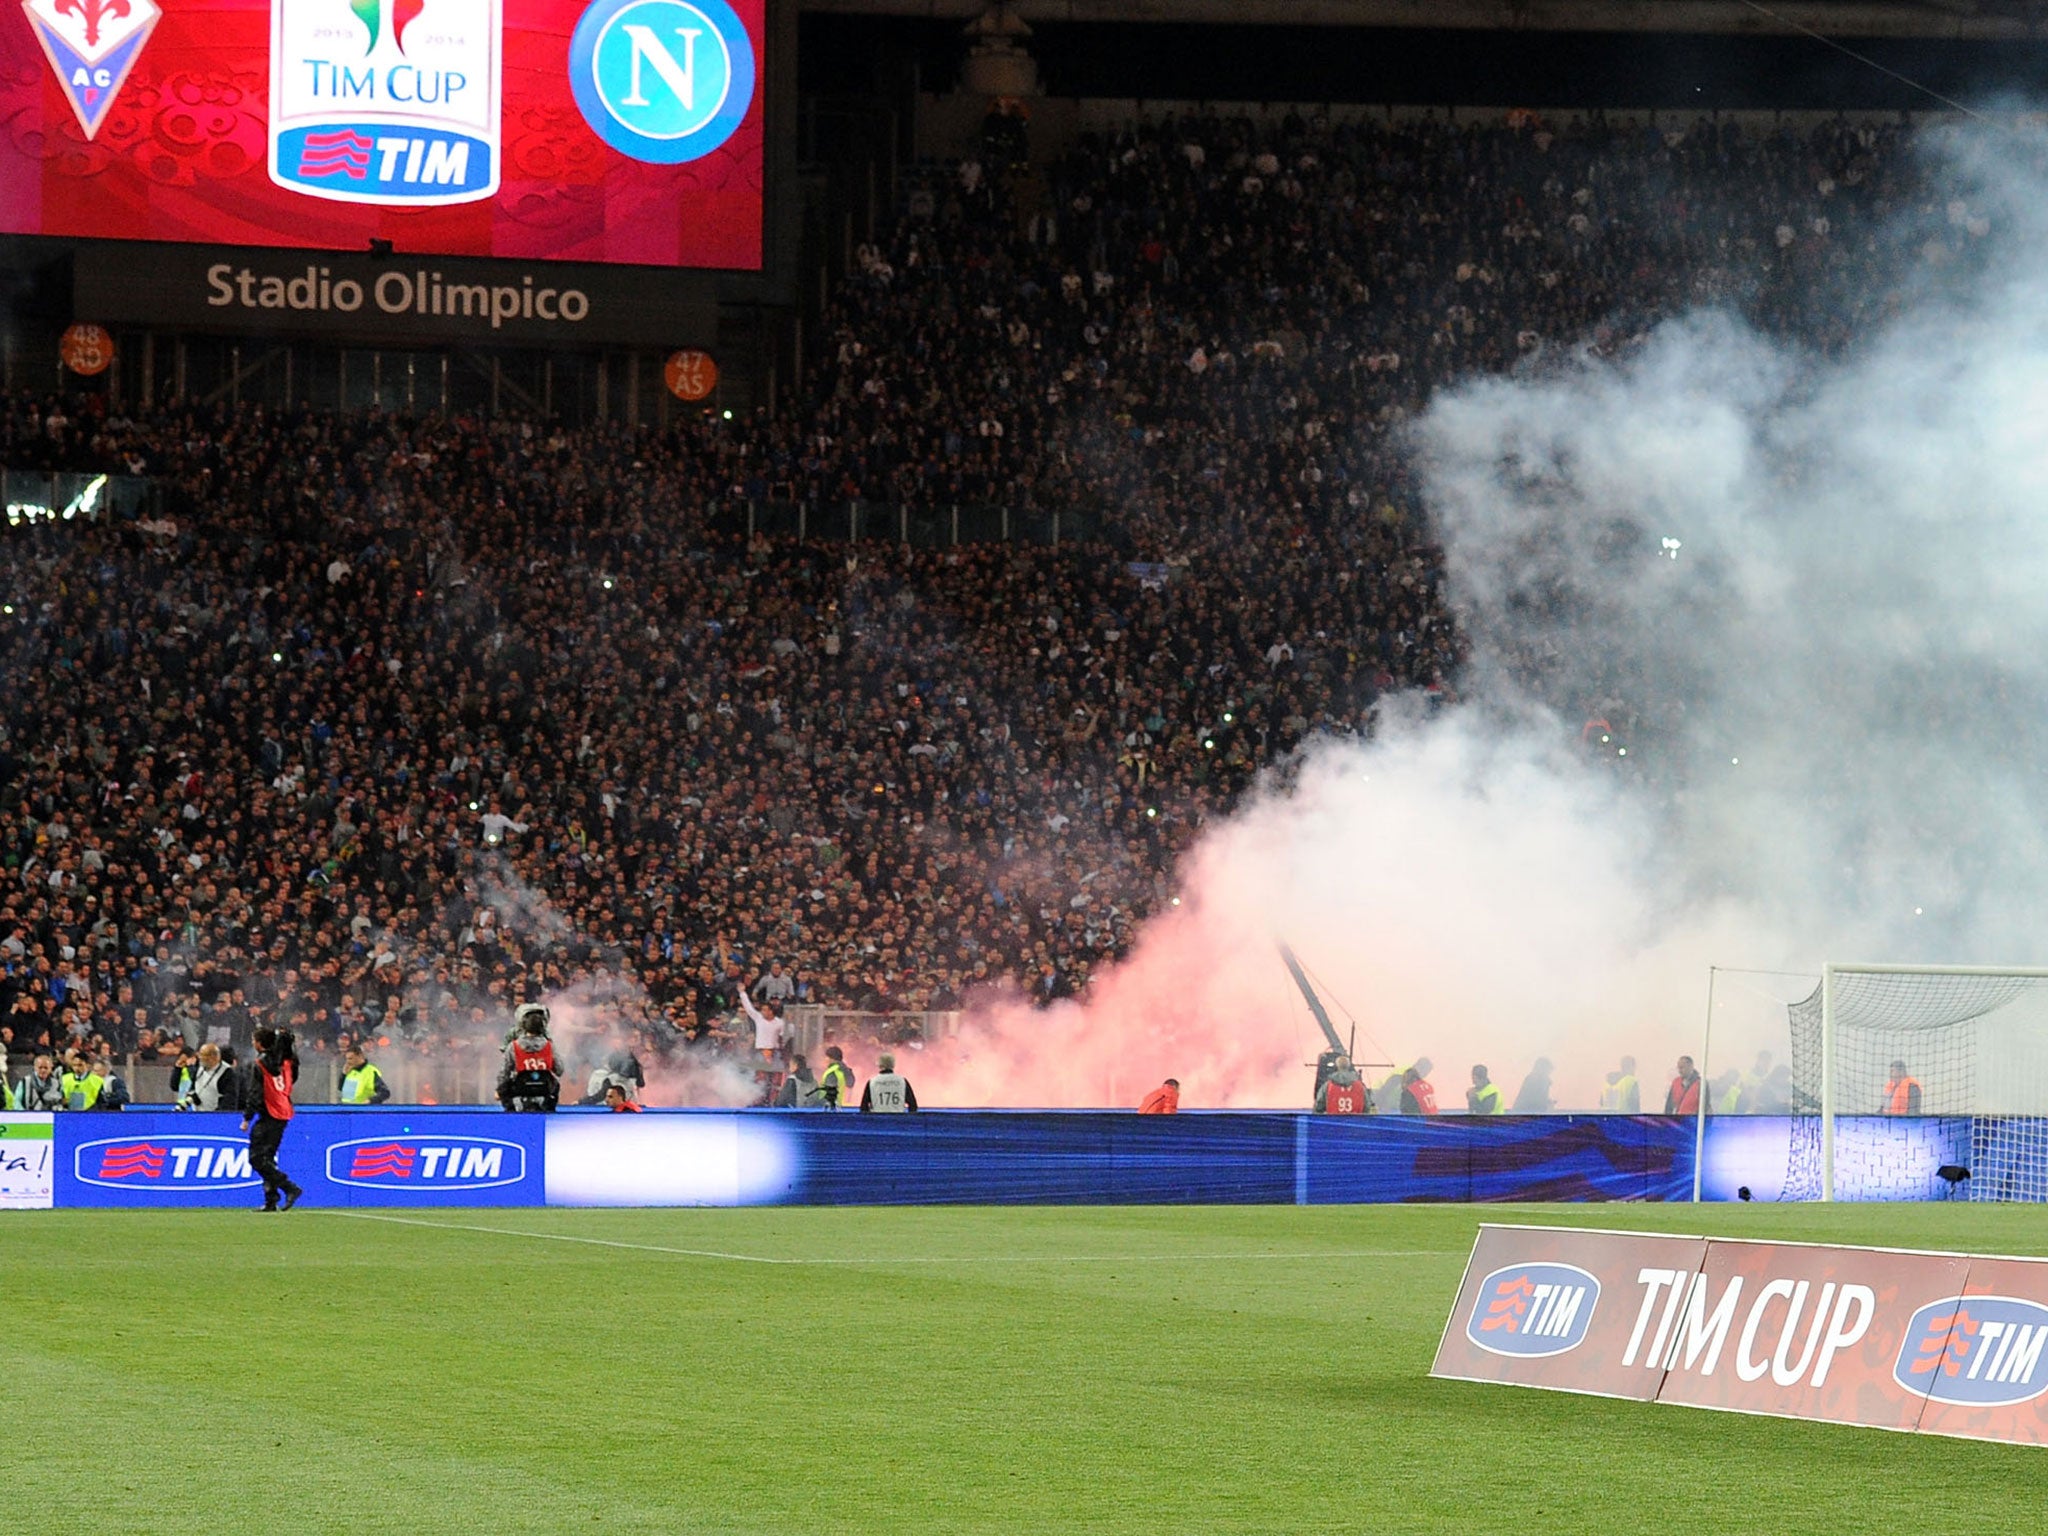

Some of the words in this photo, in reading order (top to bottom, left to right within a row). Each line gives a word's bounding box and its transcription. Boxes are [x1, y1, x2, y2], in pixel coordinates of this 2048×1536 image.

[313, 28, 353, 39] 2013
[425, 35, 466, 46] 2014
[303, 59, 374, 99] TIM
[621, 24, 703, 111] N
[376, 137, 469, 185] TIM
[207, 264, 364, 311] Stadio
[374, 271, 589, 328] Olimpico
[879, 1091, 900, 1106] 176
[1338, 1097, 1353, 1112] 93
[170, 1147, 252, 1178] TIM
[420, 1147, 503, 1178] TIM
[1520, 1283, 1586, 1338] TIM
[1621, 1268, 1743, 1376] TIM
[1735, 1279, 1876, 1388] CUP
[1966, 1321, 2048, 1386] TIM
